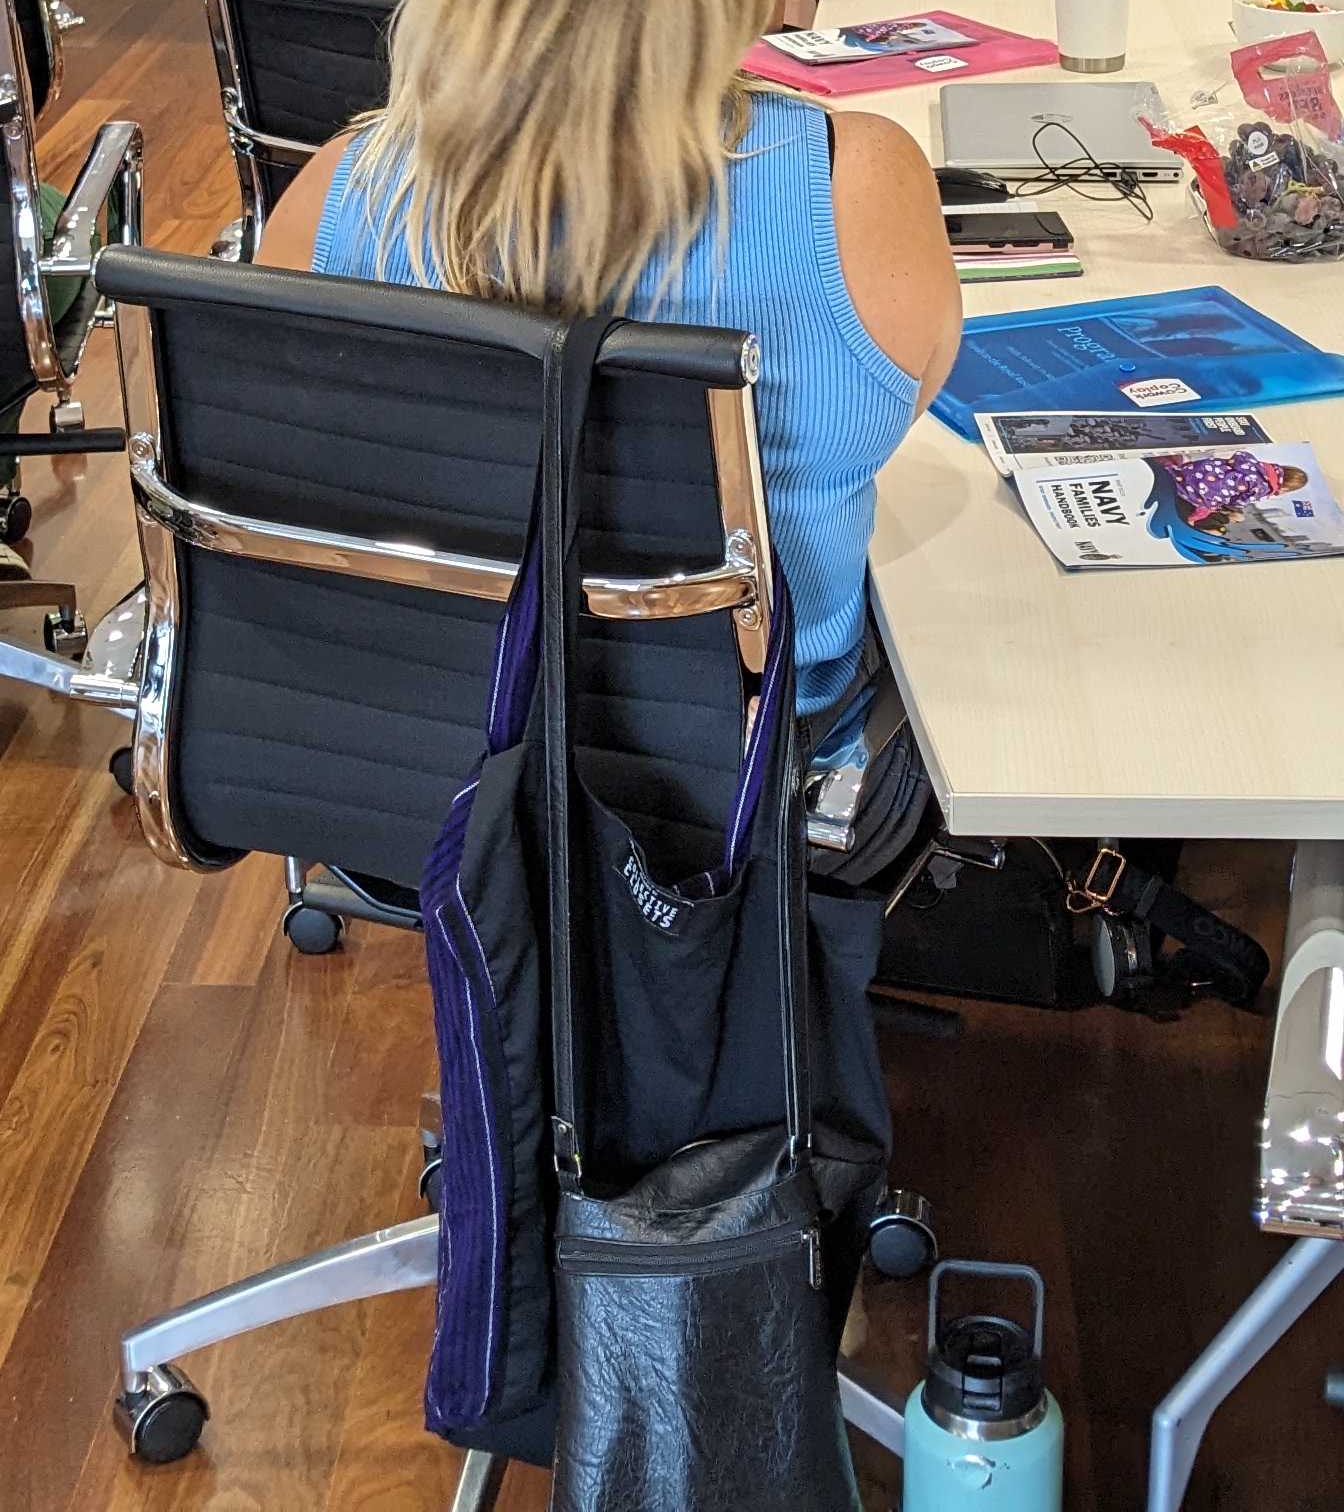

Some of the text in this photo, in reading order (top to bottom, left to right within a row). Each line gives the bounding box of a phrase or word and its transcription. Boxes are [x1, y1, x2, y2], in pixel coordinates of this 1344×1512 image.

[1129, 382, 1181, 395] Coplay
[1134, 387, 1188, 400] Cowork
[1050, 484, 1081, 529] HANDBOOK
[1069, 482, 1101, 528] FAMILIES
[1088, 480, 1130, 526] NAVY
[623, 863, 673, 928] CLOSETS
